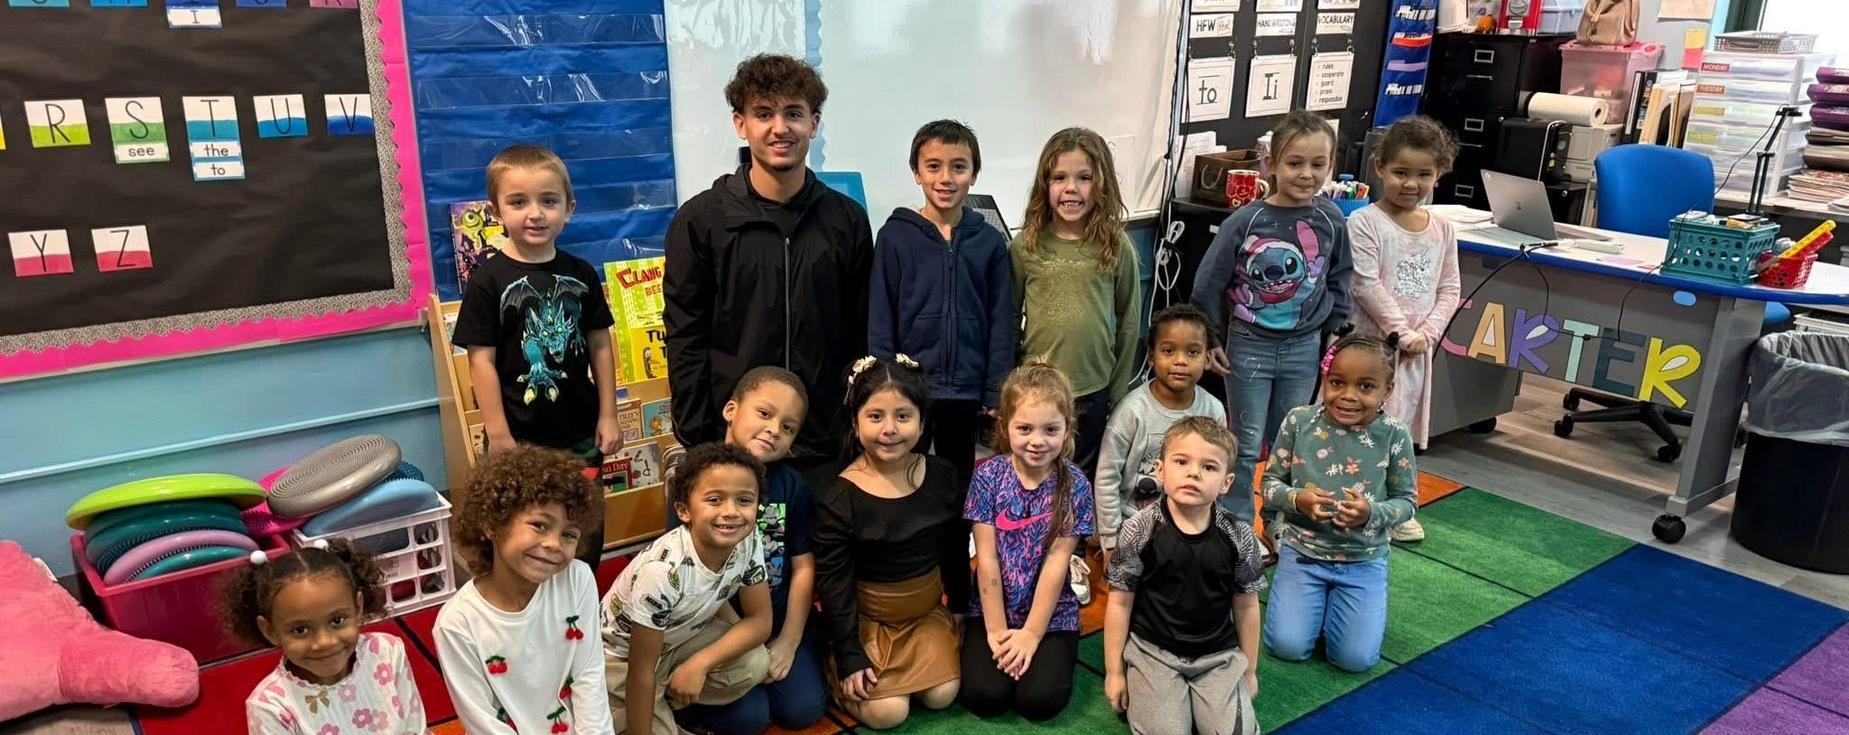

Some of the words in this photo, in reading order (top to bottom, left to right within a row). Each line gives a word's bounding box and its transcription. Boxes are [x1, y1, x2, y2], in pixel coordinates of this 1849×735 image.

[191, 10, 199, 24] I
[1317, 15, 1354, 25] VOCABULARY
[1196, 18, 1216, 32] HFW
[1702, 64, 1728, 72] MONDAY
[1198, 79, 1218, 104] to
[1262, 72, 1278, 100] Ii
[45, 104, 72, 143] R
[124, 100, 149, 140] S
[200, 99, 219, 138] T
[270, 97, 291, 135] U
[339, 96, 358, 132] V
[128, 147, 155, 157] see
[203, 144, 229, 157] the
[210, 163, 226, 177] to
[30, 233, 48, 272] Y
[110, 229, 137, 268] Z
